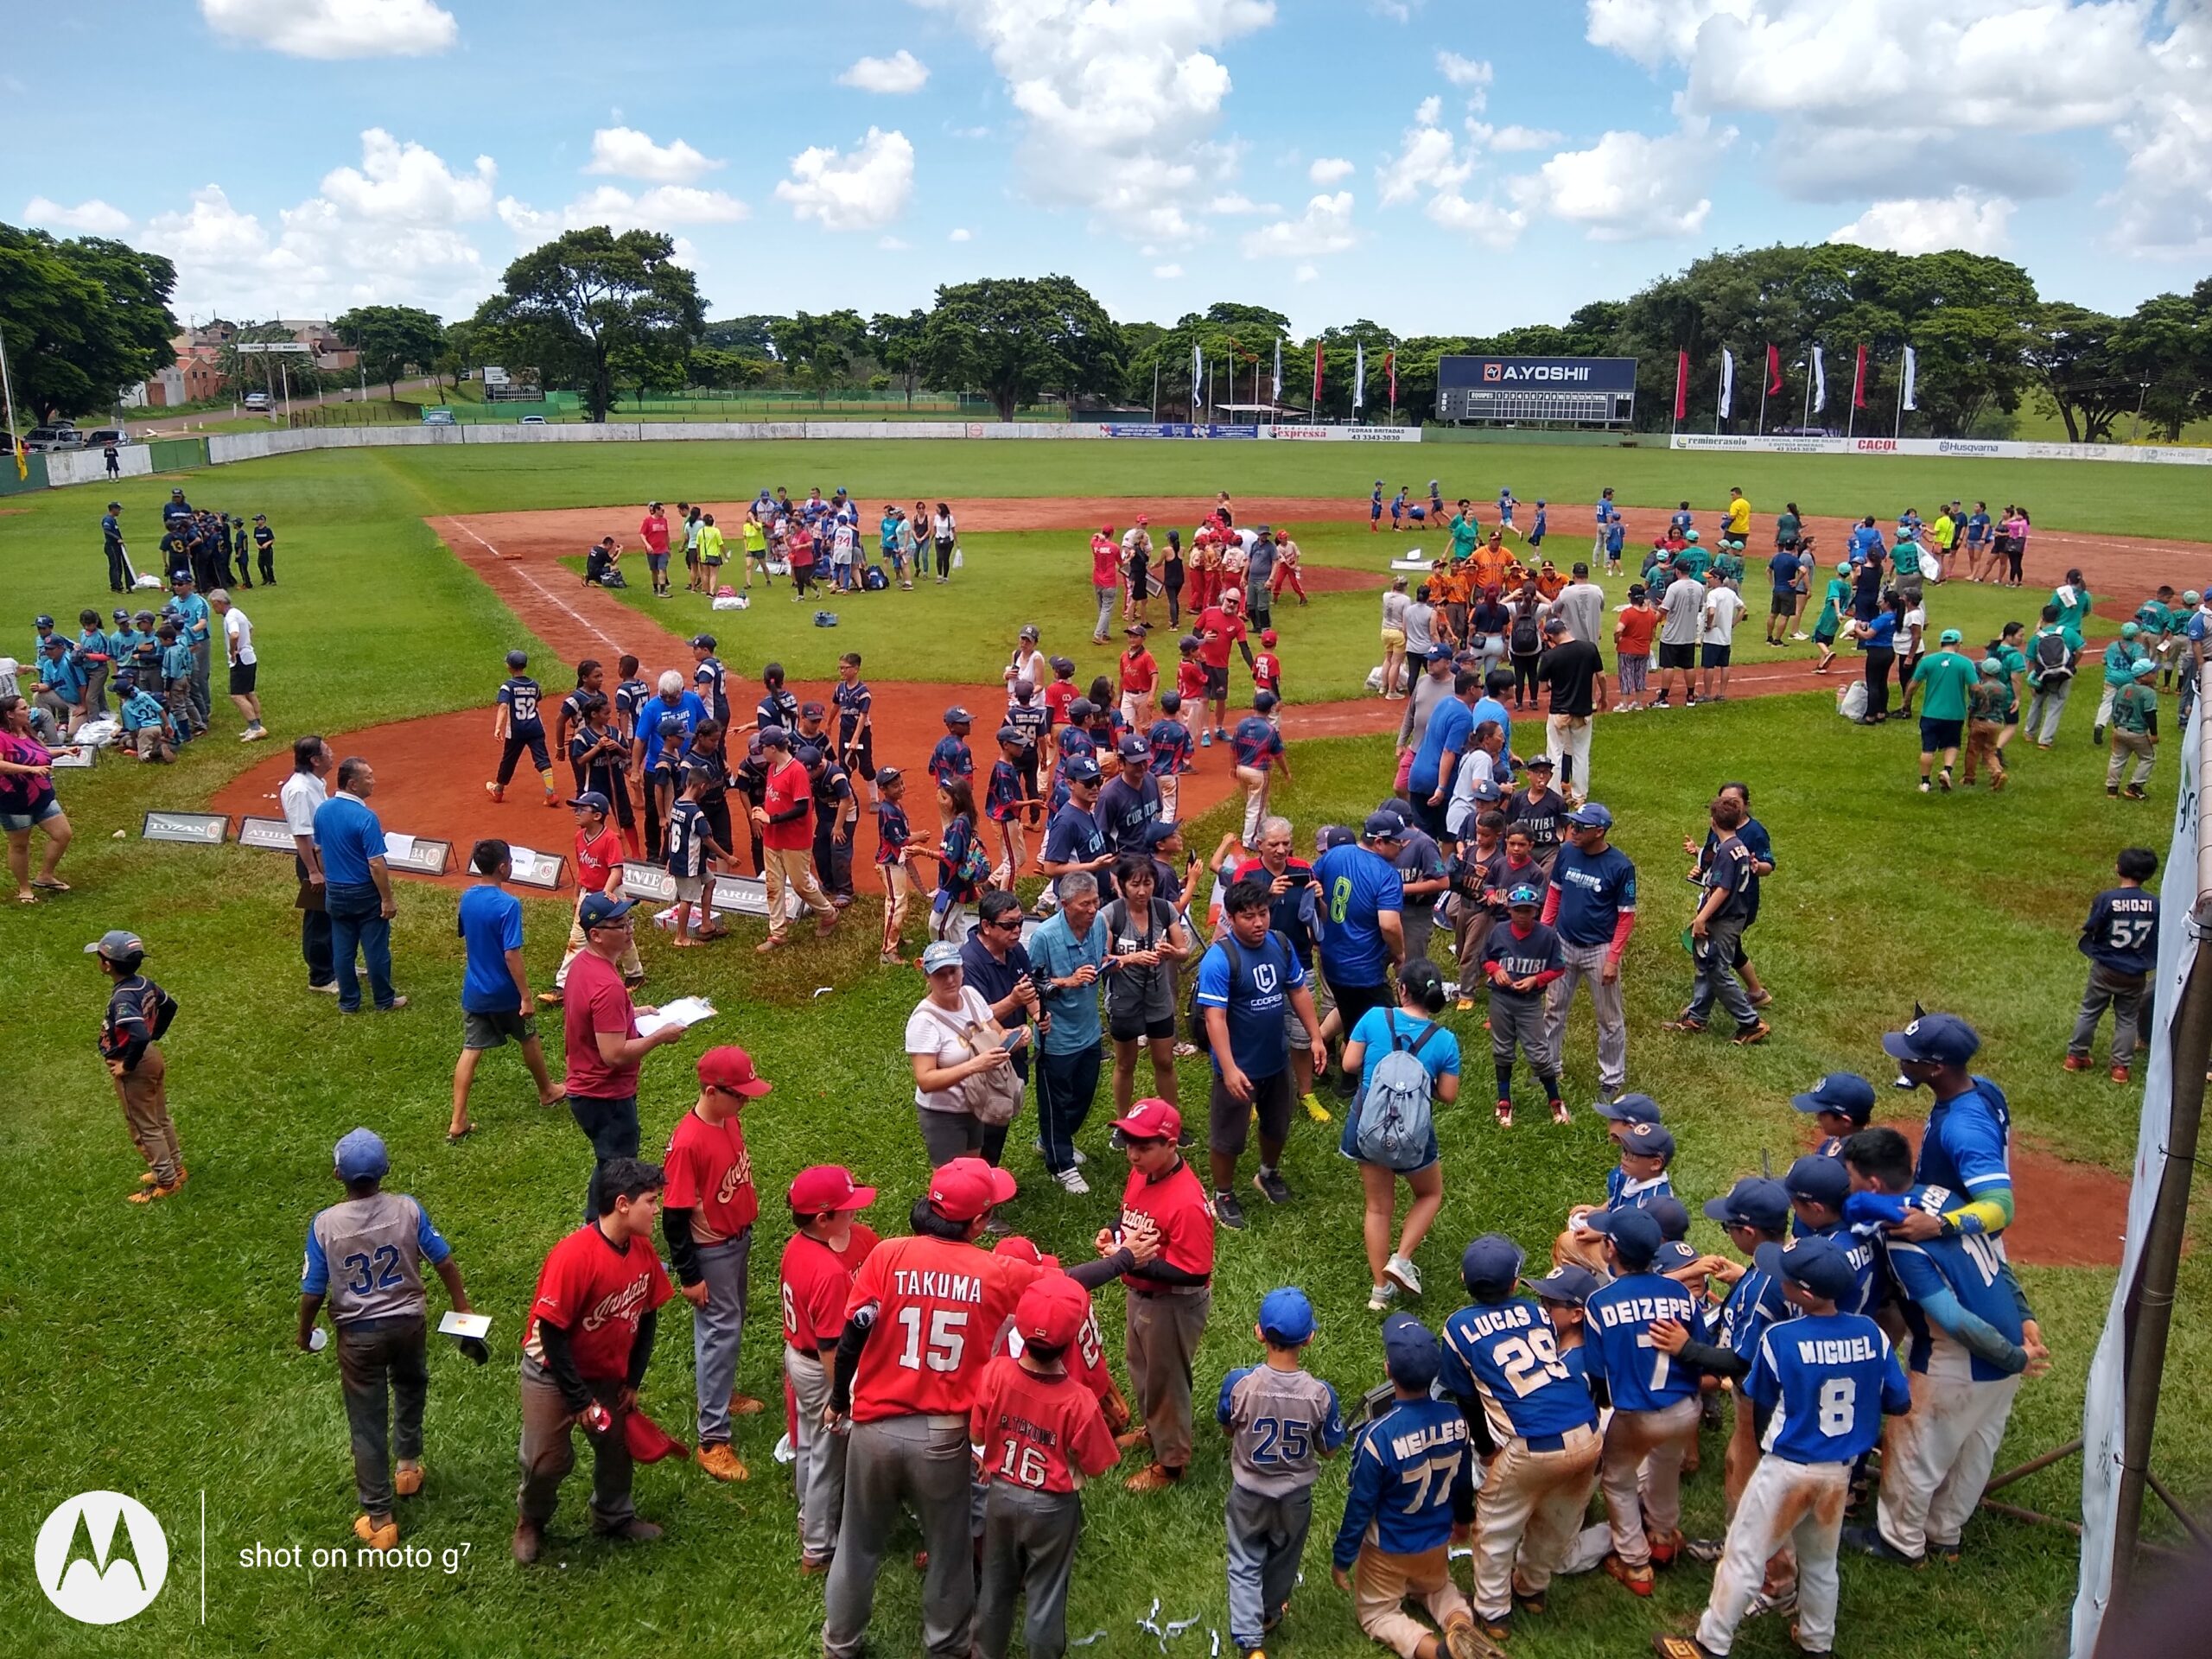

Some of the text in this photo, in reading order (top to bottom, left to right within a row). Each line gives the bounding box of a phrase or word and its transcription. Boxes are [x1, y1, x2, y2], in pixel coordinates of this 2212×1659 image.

[1502, 365, 1589, 381] A.YOSHII
[1278, 429, 1327, 439] expressa
[1688, 436, 1747, 446] reminerasolo
[1858, 439, 1897, 450] CACOL
[1950, 442, 1999, 453] Husqvarna
[836, 535, 851, 547] 34
[1255, 663, 1268, 679] 79
[138, 703, 157, 721] 23
[514, 697, 537, 721] 52
[149, 822, 206, 834] TOZAN
[247, 829, 296, 841] ATIBA
[1538, 831, 1553, 842] 19
[579, 849, 601, 868] Mogi
[623, 869, 661, 891] ANTE
[1329, 876, 1352, 924] 8
[2111, 899, 2153, 912] SHOJI
[2110, 918, 2154, 950] 57
[1250, 993, 1282, 1007] COOPER
[342, 1243, 405, 1297] 32
[1961, 1232, 2000, 1288] 10
[893, 1269, 982, 1304] TAKUMA
[1459, 1306, 1532, 1344] LUCAS
[898, 1306, 969, 1373] 15
[1796, 1335, 1877, 1365] MIGUEL
[1492, 1327, 1572, 1400] 29
[1818, 1376, 1857, 1438] 8
[1251, 1416, 1311, 1464] 25
[1000, 1439, 1047, 1487] 16
[1401, 1449, 1463, 1515] 77
